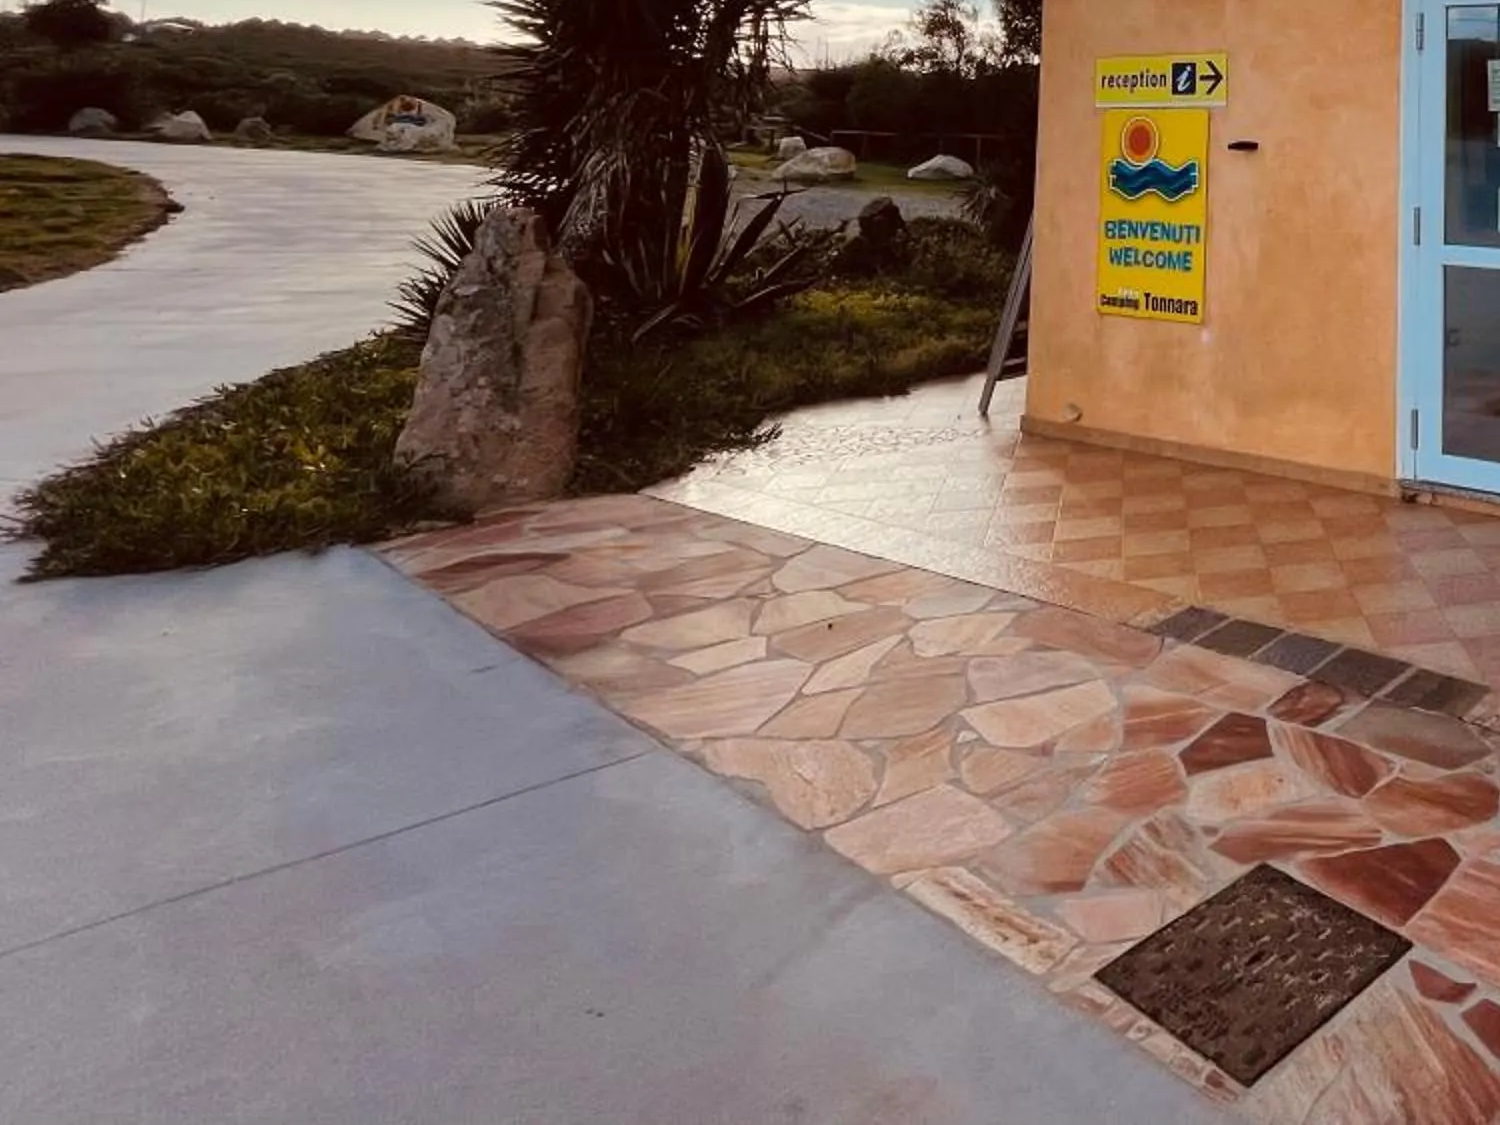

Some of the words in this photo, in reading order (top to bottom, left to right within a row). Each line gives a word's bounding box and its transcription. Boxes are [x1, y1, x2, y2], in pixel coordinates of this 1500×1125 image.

[1101, 69, 1167, 93] reception
[1104, 220, 1200, 244] BENVENUTI
[1109, 246, 1193, 271] WELCOME
[1144, 292, 1198, 316] Tonnara
